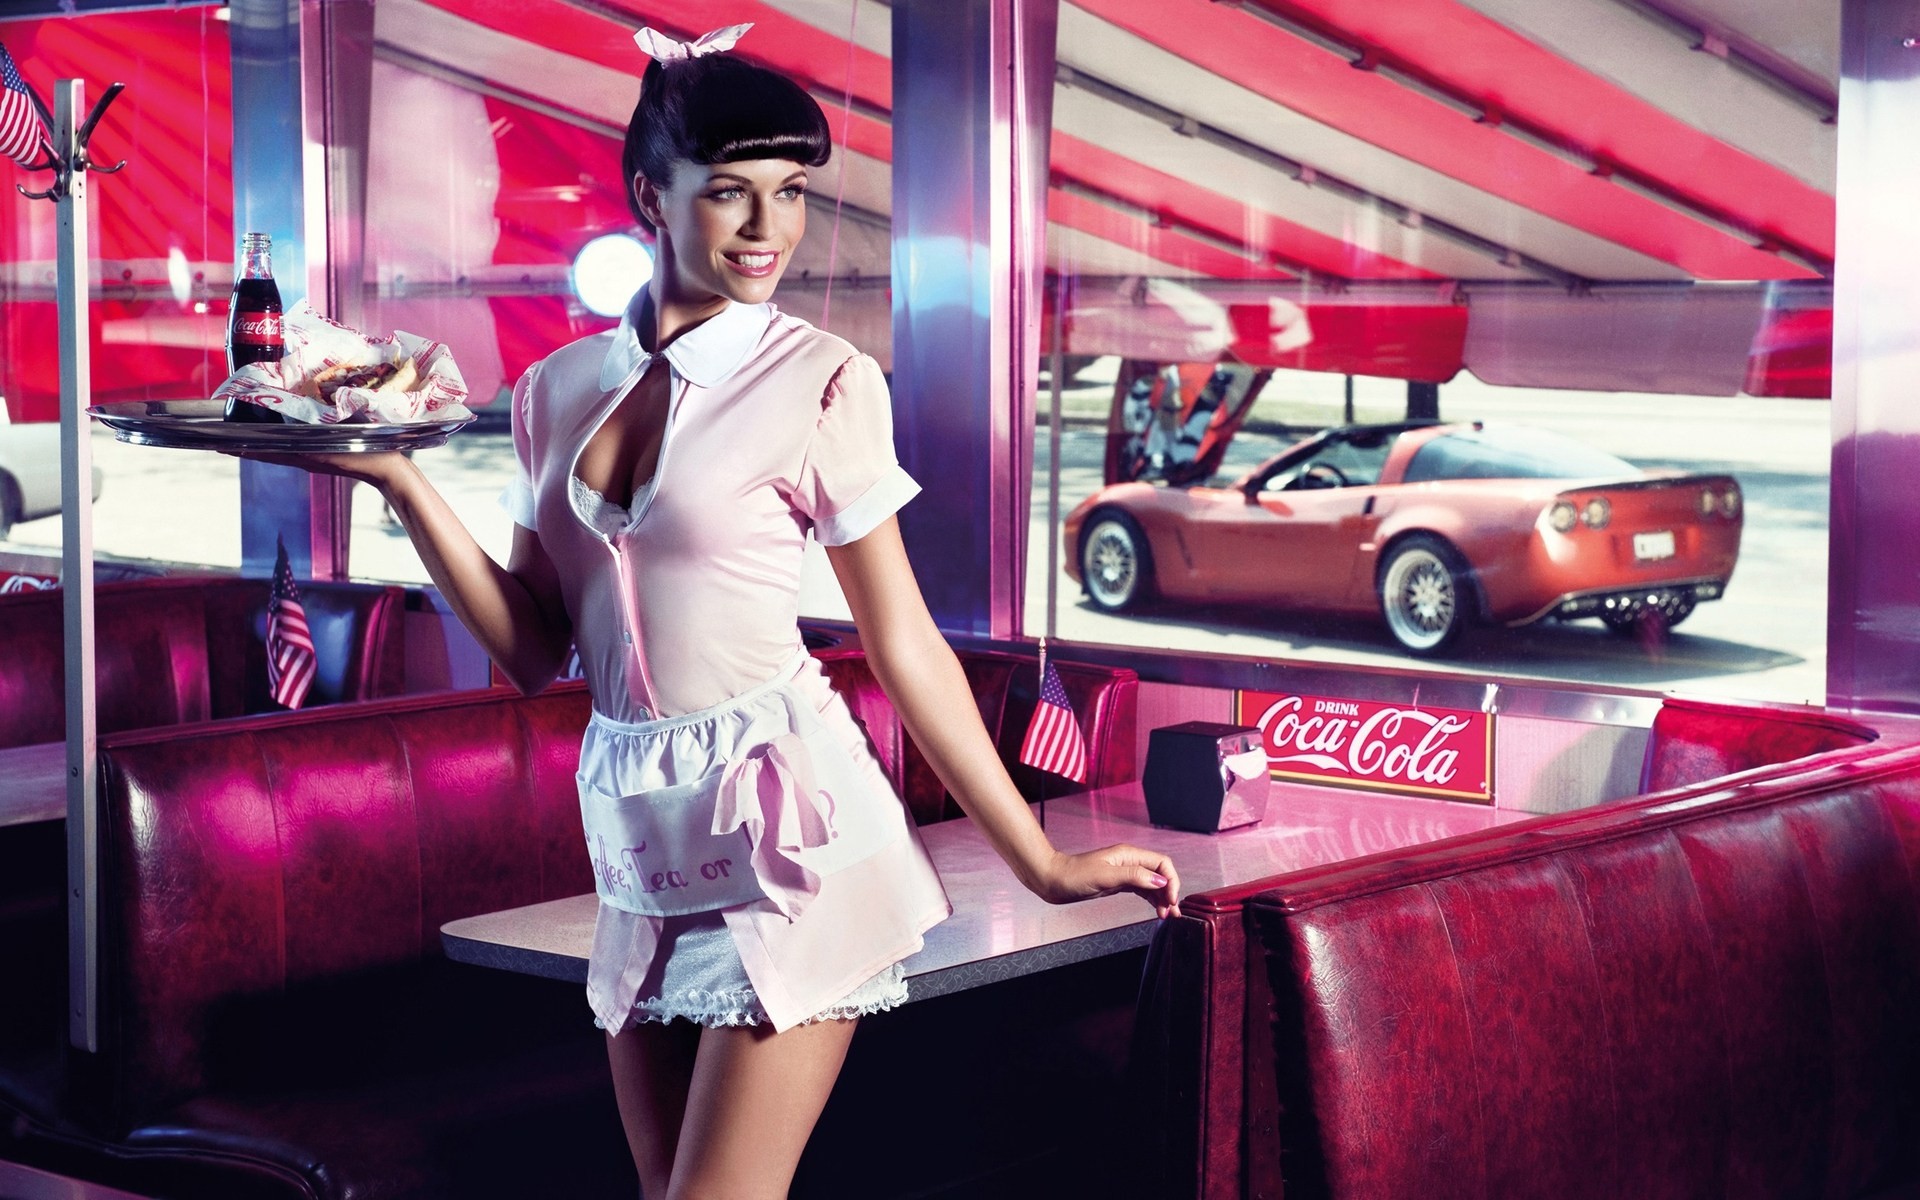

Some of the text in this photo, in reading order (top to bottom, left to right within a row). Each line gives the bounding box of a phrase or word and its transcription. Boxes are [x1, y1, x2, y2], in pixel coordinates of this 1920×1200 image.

[234, 317, 279, 335] Coca-Cola
[1314, 700, 1360, 717] DRINK
[1256, 696, 1473, 785] Coca-Cola
[583, 830, 632, 897] offee,
[620, 840, 689, 894] Tea
[700, 858, 733, 881] or
